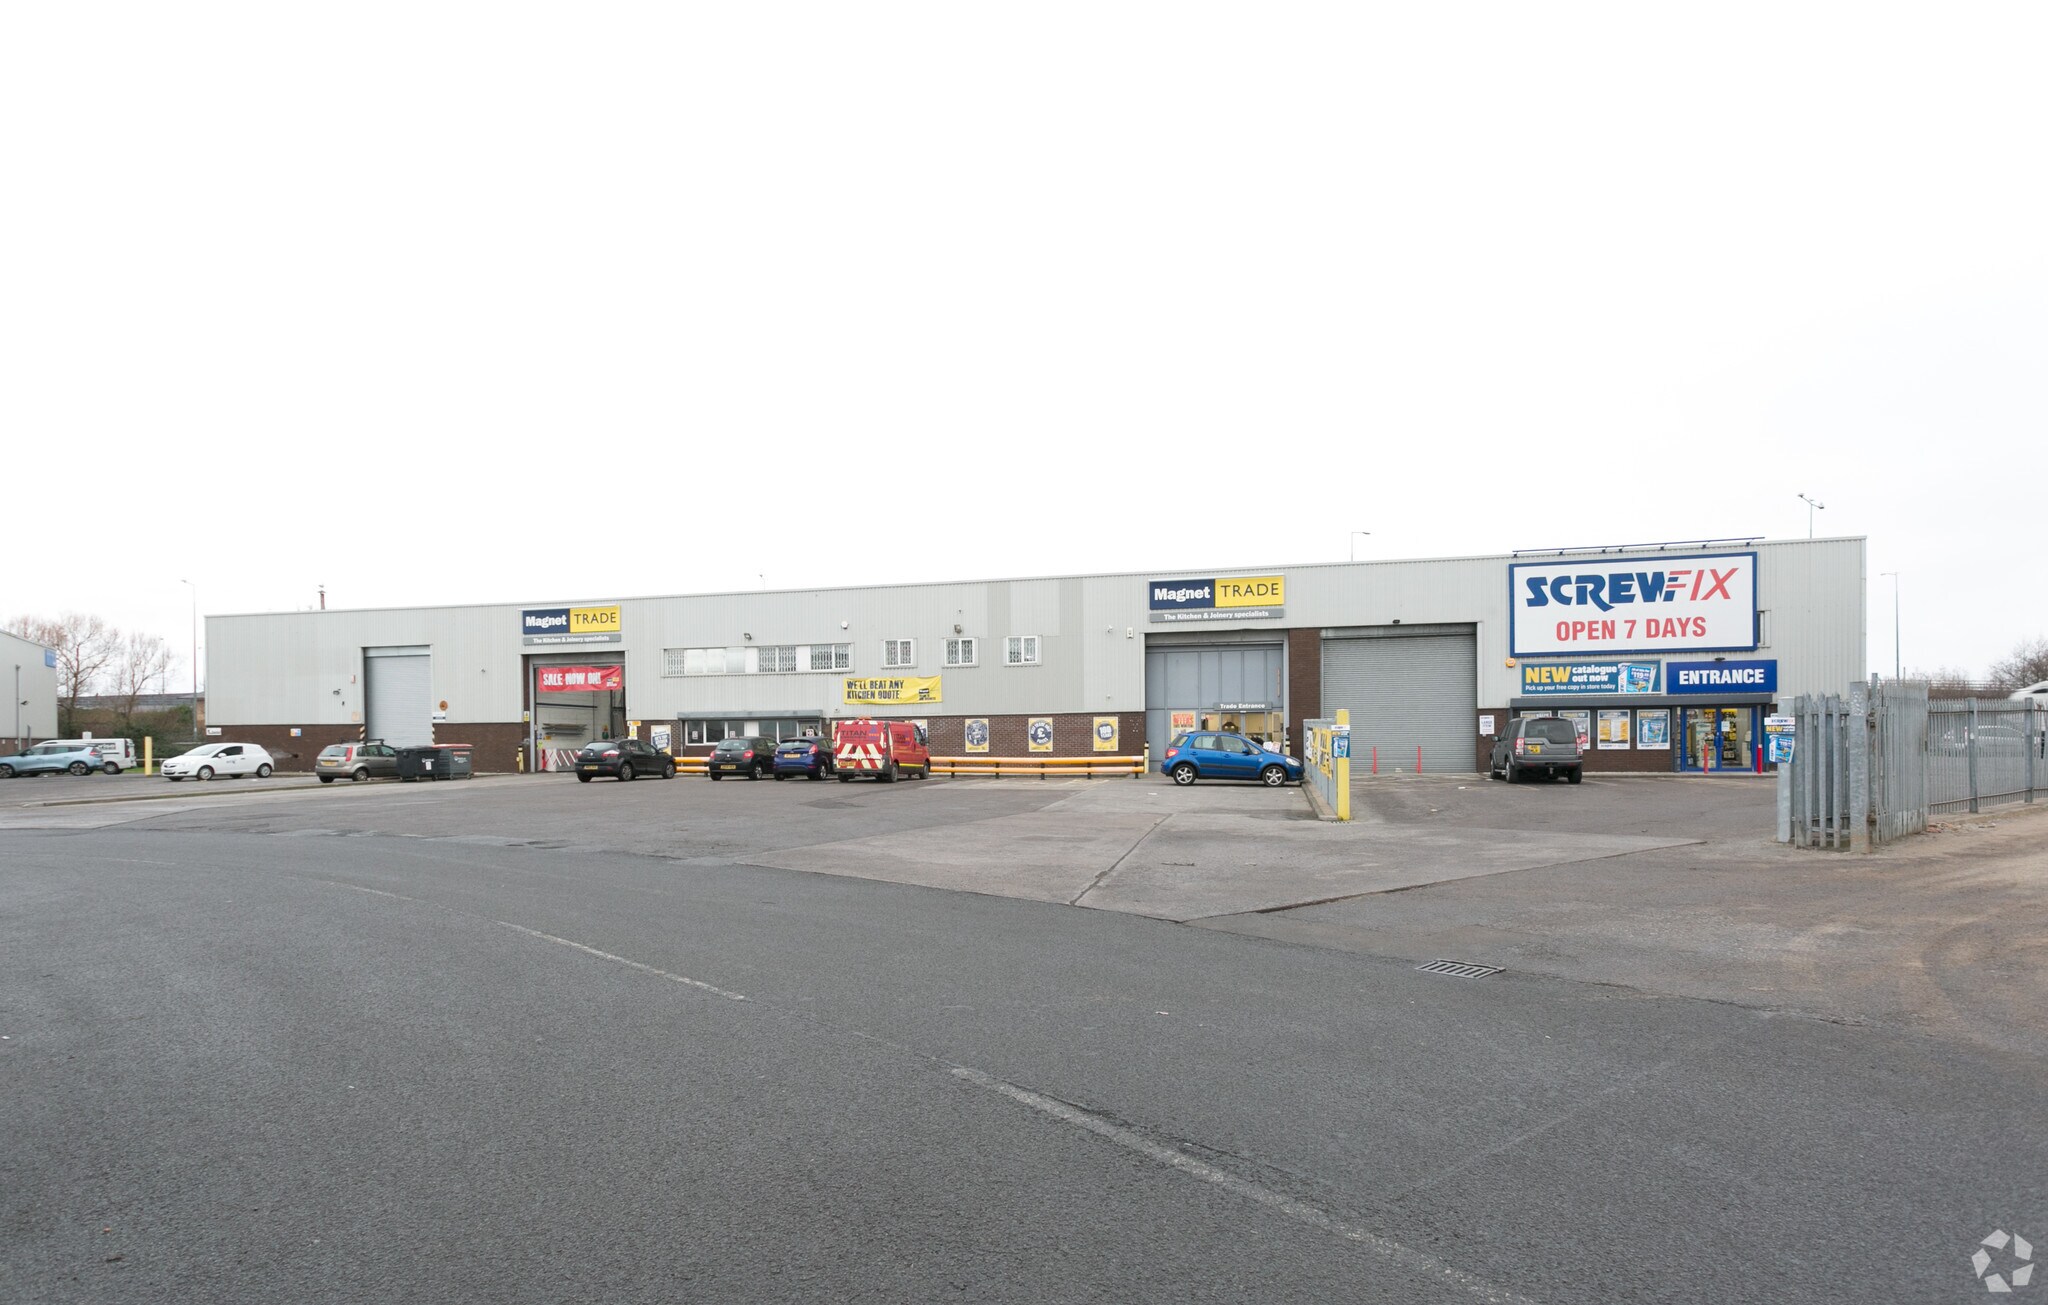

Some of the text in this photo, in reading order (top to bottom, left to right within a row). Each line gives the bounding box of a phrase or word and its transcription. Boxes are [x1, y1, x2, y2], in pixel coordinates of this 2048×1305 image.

[1154, 583, 1279, 602] Magnet TRADE
[1526, 567, 1739, 612] SCREWFIX
[525, 612, 616, 628] Magnet TRADE
[1234, 610, 1269, 618] specialists
[1556, 616, 1707, 642] OPEN 7 DAYS
[543, 673, 563, 685] SALE
[565, 673, 585, 685] NOW
[588, 672, 601, 685] ON!
[1525, 665, 1617, 683] NEW catalogue
[1589, 674, 1609, 682] now
[1679, 669, 1764, 684] ENTRANCE
[847, 680, 904, 689] WE'LL BEAT ANY
[847, 690, 875, 699] KITCHEN
[1037, 727, 1045, 737] £
